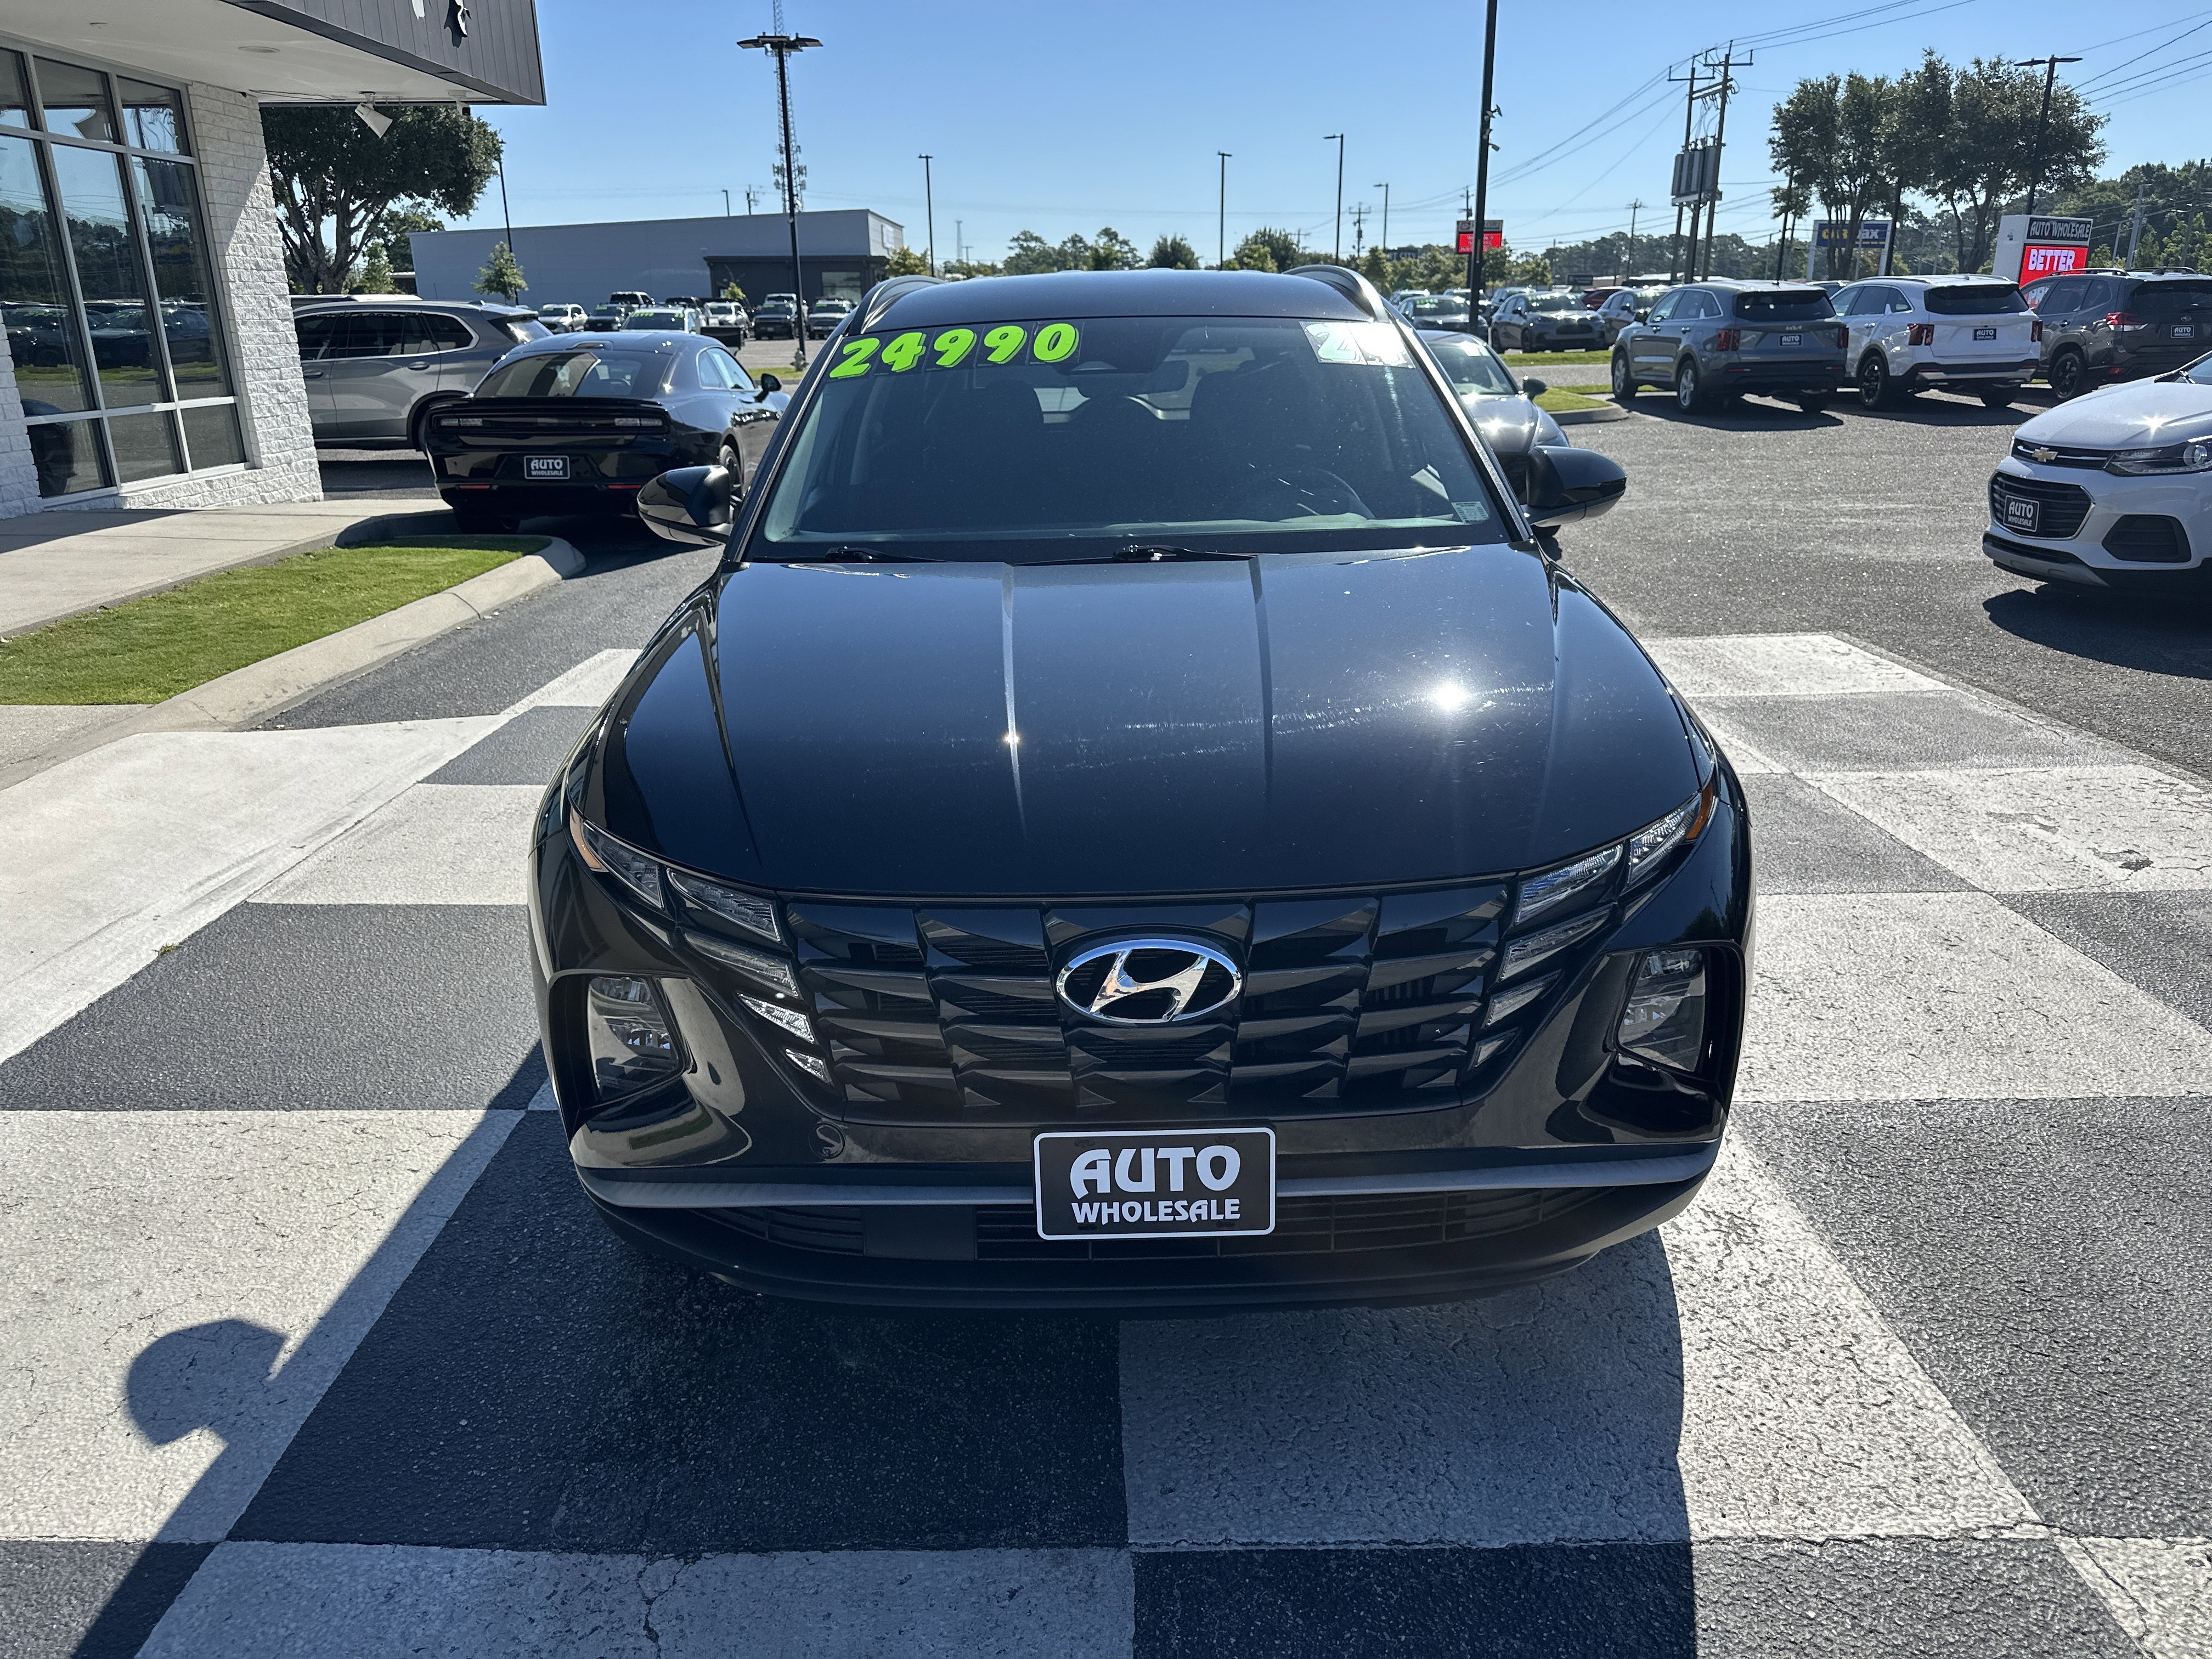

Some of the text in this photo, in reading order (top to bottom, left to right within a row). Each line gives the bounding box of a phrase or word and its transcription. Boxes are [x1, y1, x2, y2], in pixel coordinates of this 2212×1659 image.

[2030, 221, 2090, 239] AUTO WHOLESALE
[2028, 249, 2075, 271] BETTER
[829, 323, 1080, 380] 24990
[531, 459, 563, 470] AUTO
[2008, 501, 2034, 518] AUTO
[2008, 516, 2033, 527] WHOLESALE
[1070, 1145, 1241, 1199] AUTO
[1071, 1198, 1241, 1226] WHOLESALE
